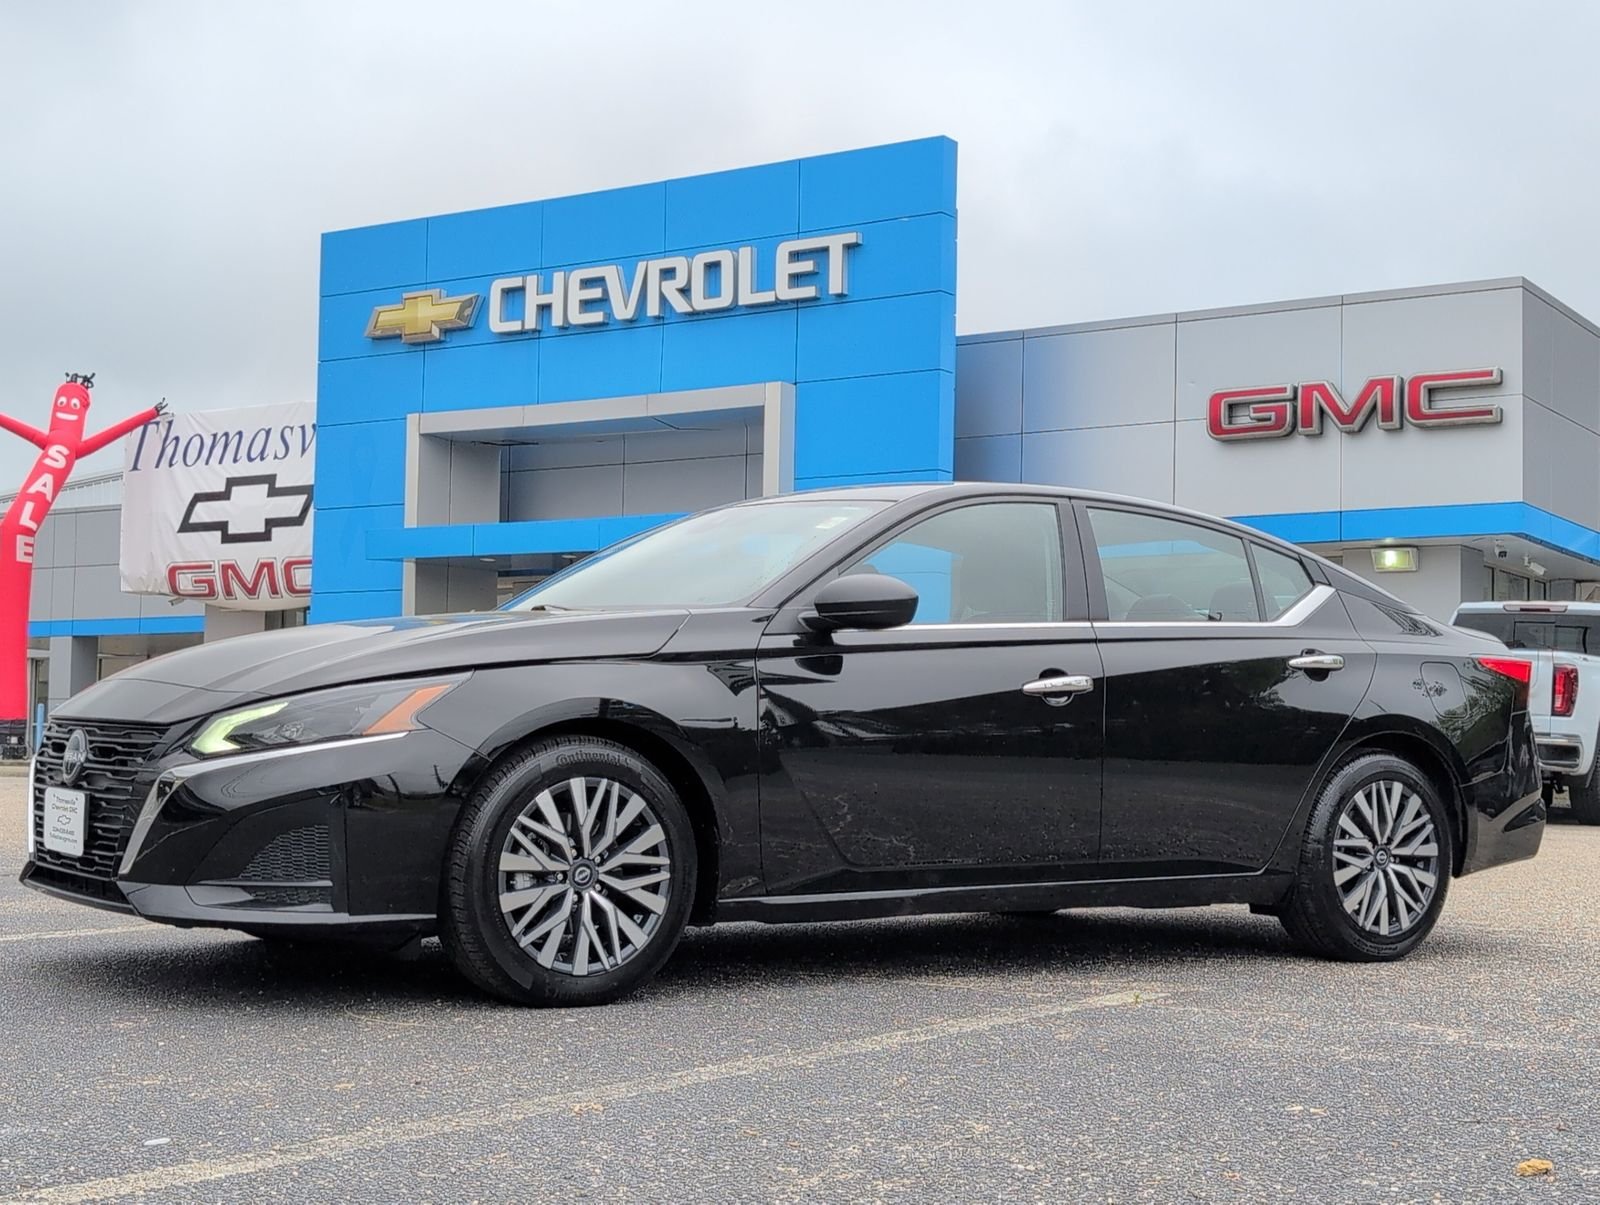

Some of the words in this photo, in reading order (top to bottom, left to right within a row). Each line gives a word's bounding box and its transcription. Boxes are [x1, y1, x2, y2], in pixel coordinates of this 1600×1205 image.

[489, 231, 862, 334] CHEVROLET
[1206, 367, 1502, 441] GMC
[15, 444, 70, 564] SALE
[166, 557, 312, 600] GMC
